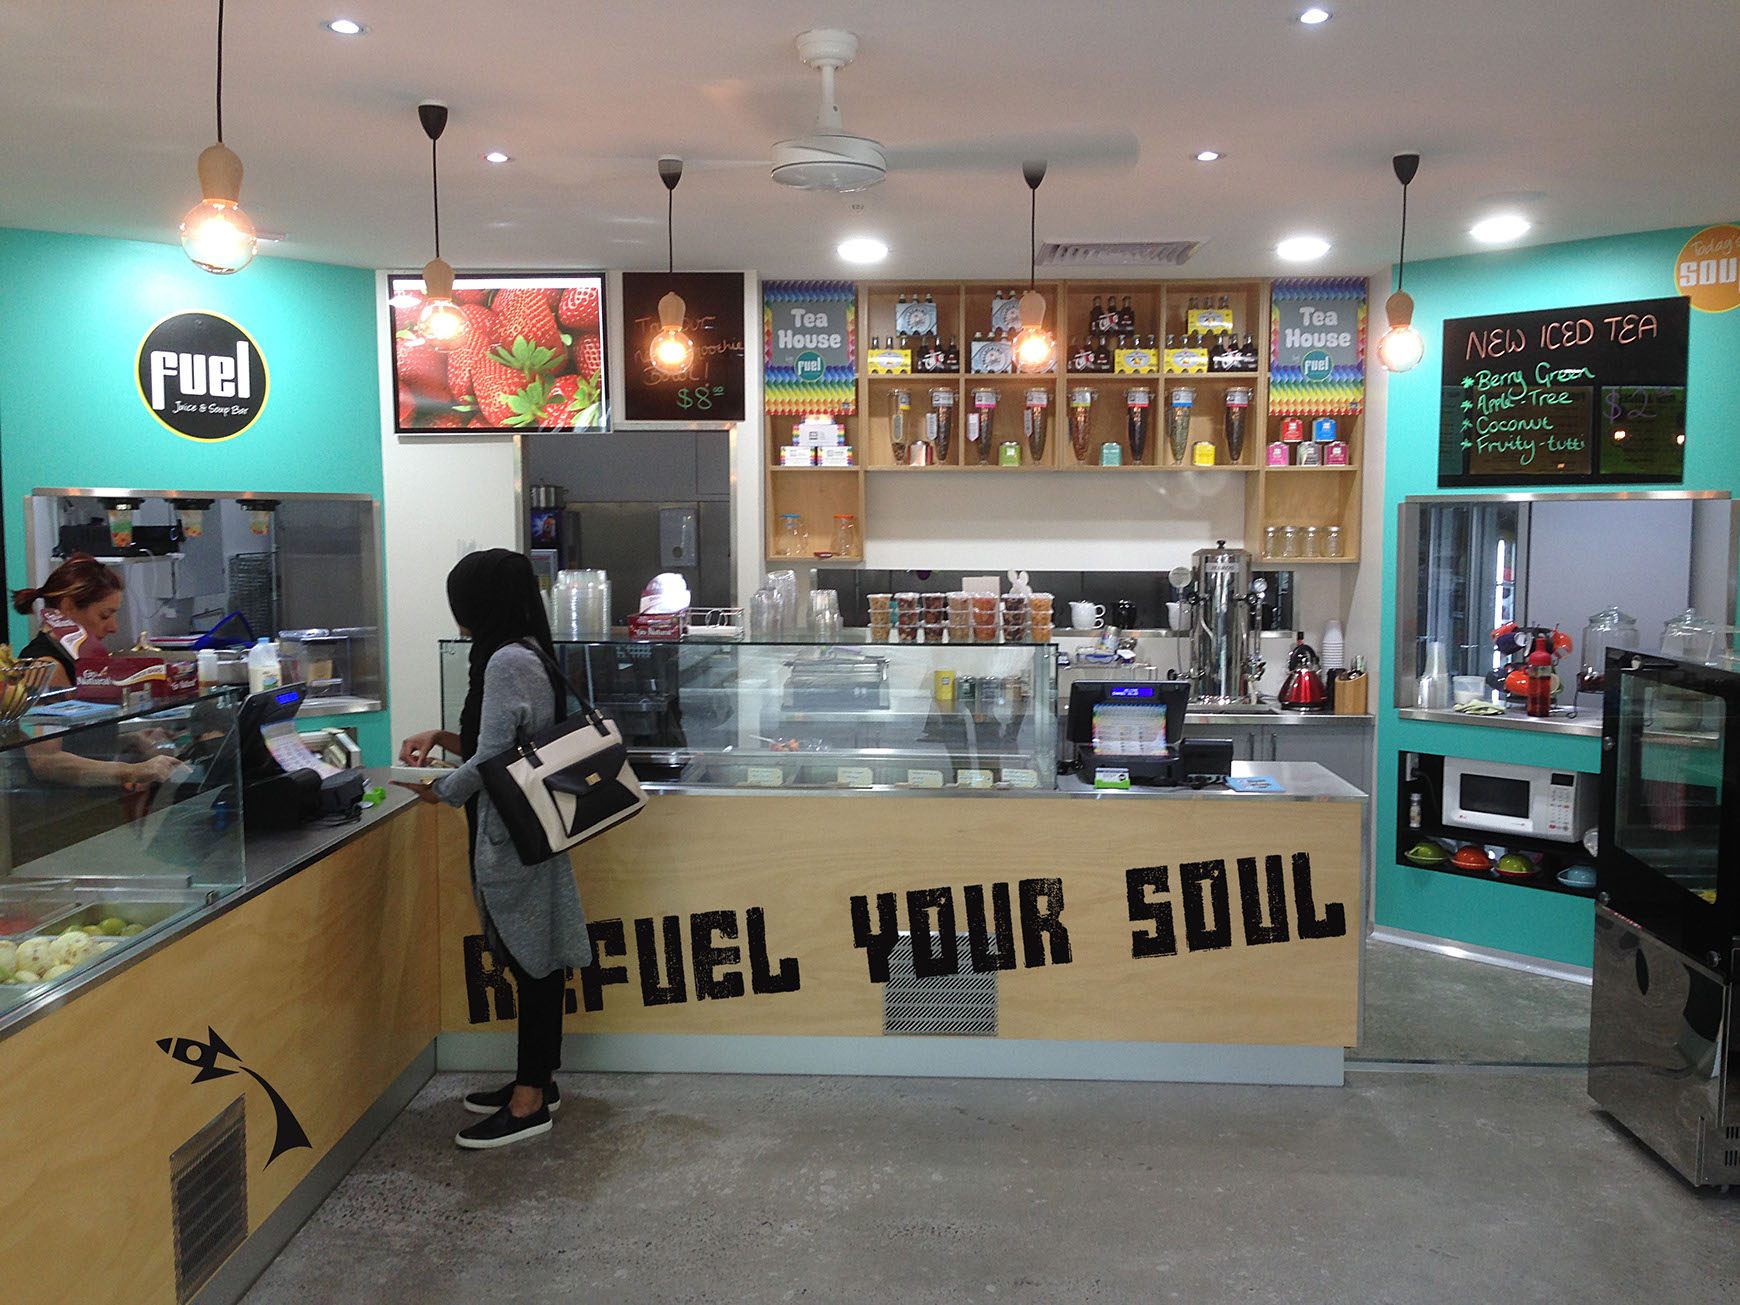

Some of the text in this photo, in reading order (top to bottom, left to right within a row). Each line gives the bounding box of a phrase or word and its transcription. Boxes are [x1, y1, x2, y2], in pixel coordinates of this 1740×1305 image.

[790, 308, 828, 328] Tea
[1299, 306, 1338, 326] Tea
[777, 329, 842, 349] House
[1285, 328, 1351, 348] House
[1466, 313, 1658, 360] NEW ICED TEA
[150, 340, 251, 411] fuel
[797, 356, 822, 376] fuel
[1304, 356, 1330, 375] fuel
[1475, 361, 1596, 400] Berry Green
[172, 400, 249, 418] Juice & Soup Bar
[1476, 415, 1555, 435] Coconut
[463, 852, 1347, 1025] RFUEL YOUR SOUL
